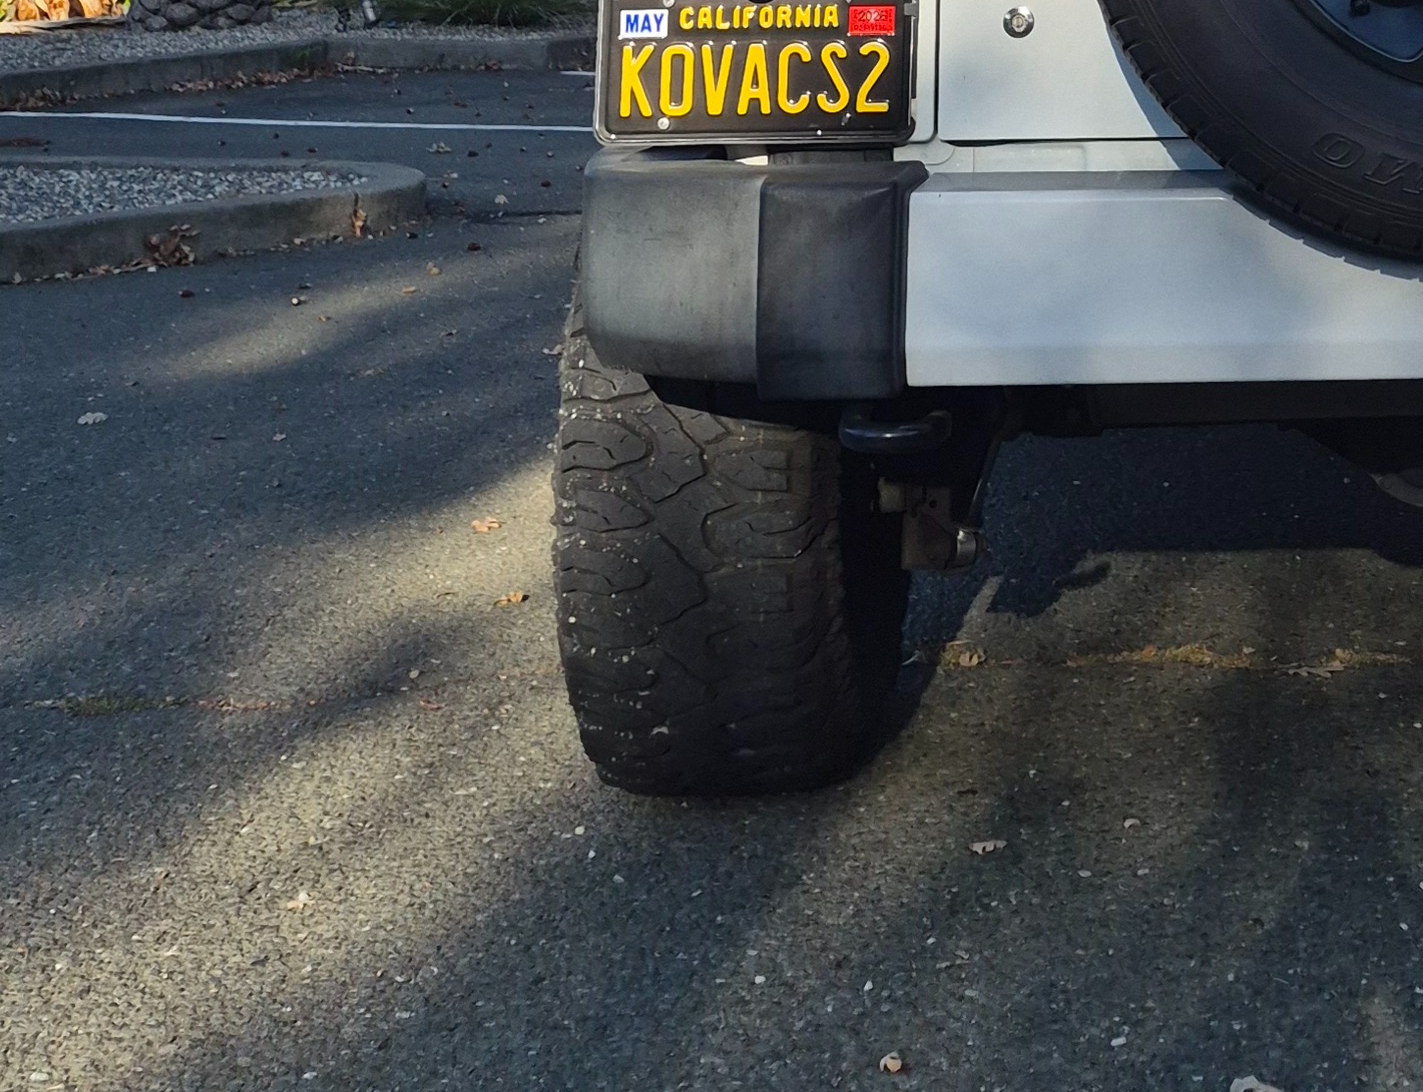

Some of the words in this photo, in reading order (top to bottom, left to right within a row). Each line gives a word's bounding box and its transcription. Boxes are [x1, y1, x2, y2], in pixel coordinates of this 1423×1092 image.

[625, 13, 664, 33] MAY
[680, 4, 839, 30] CALIFORNIA
[619, 39, 890, 118] KOVACS2
